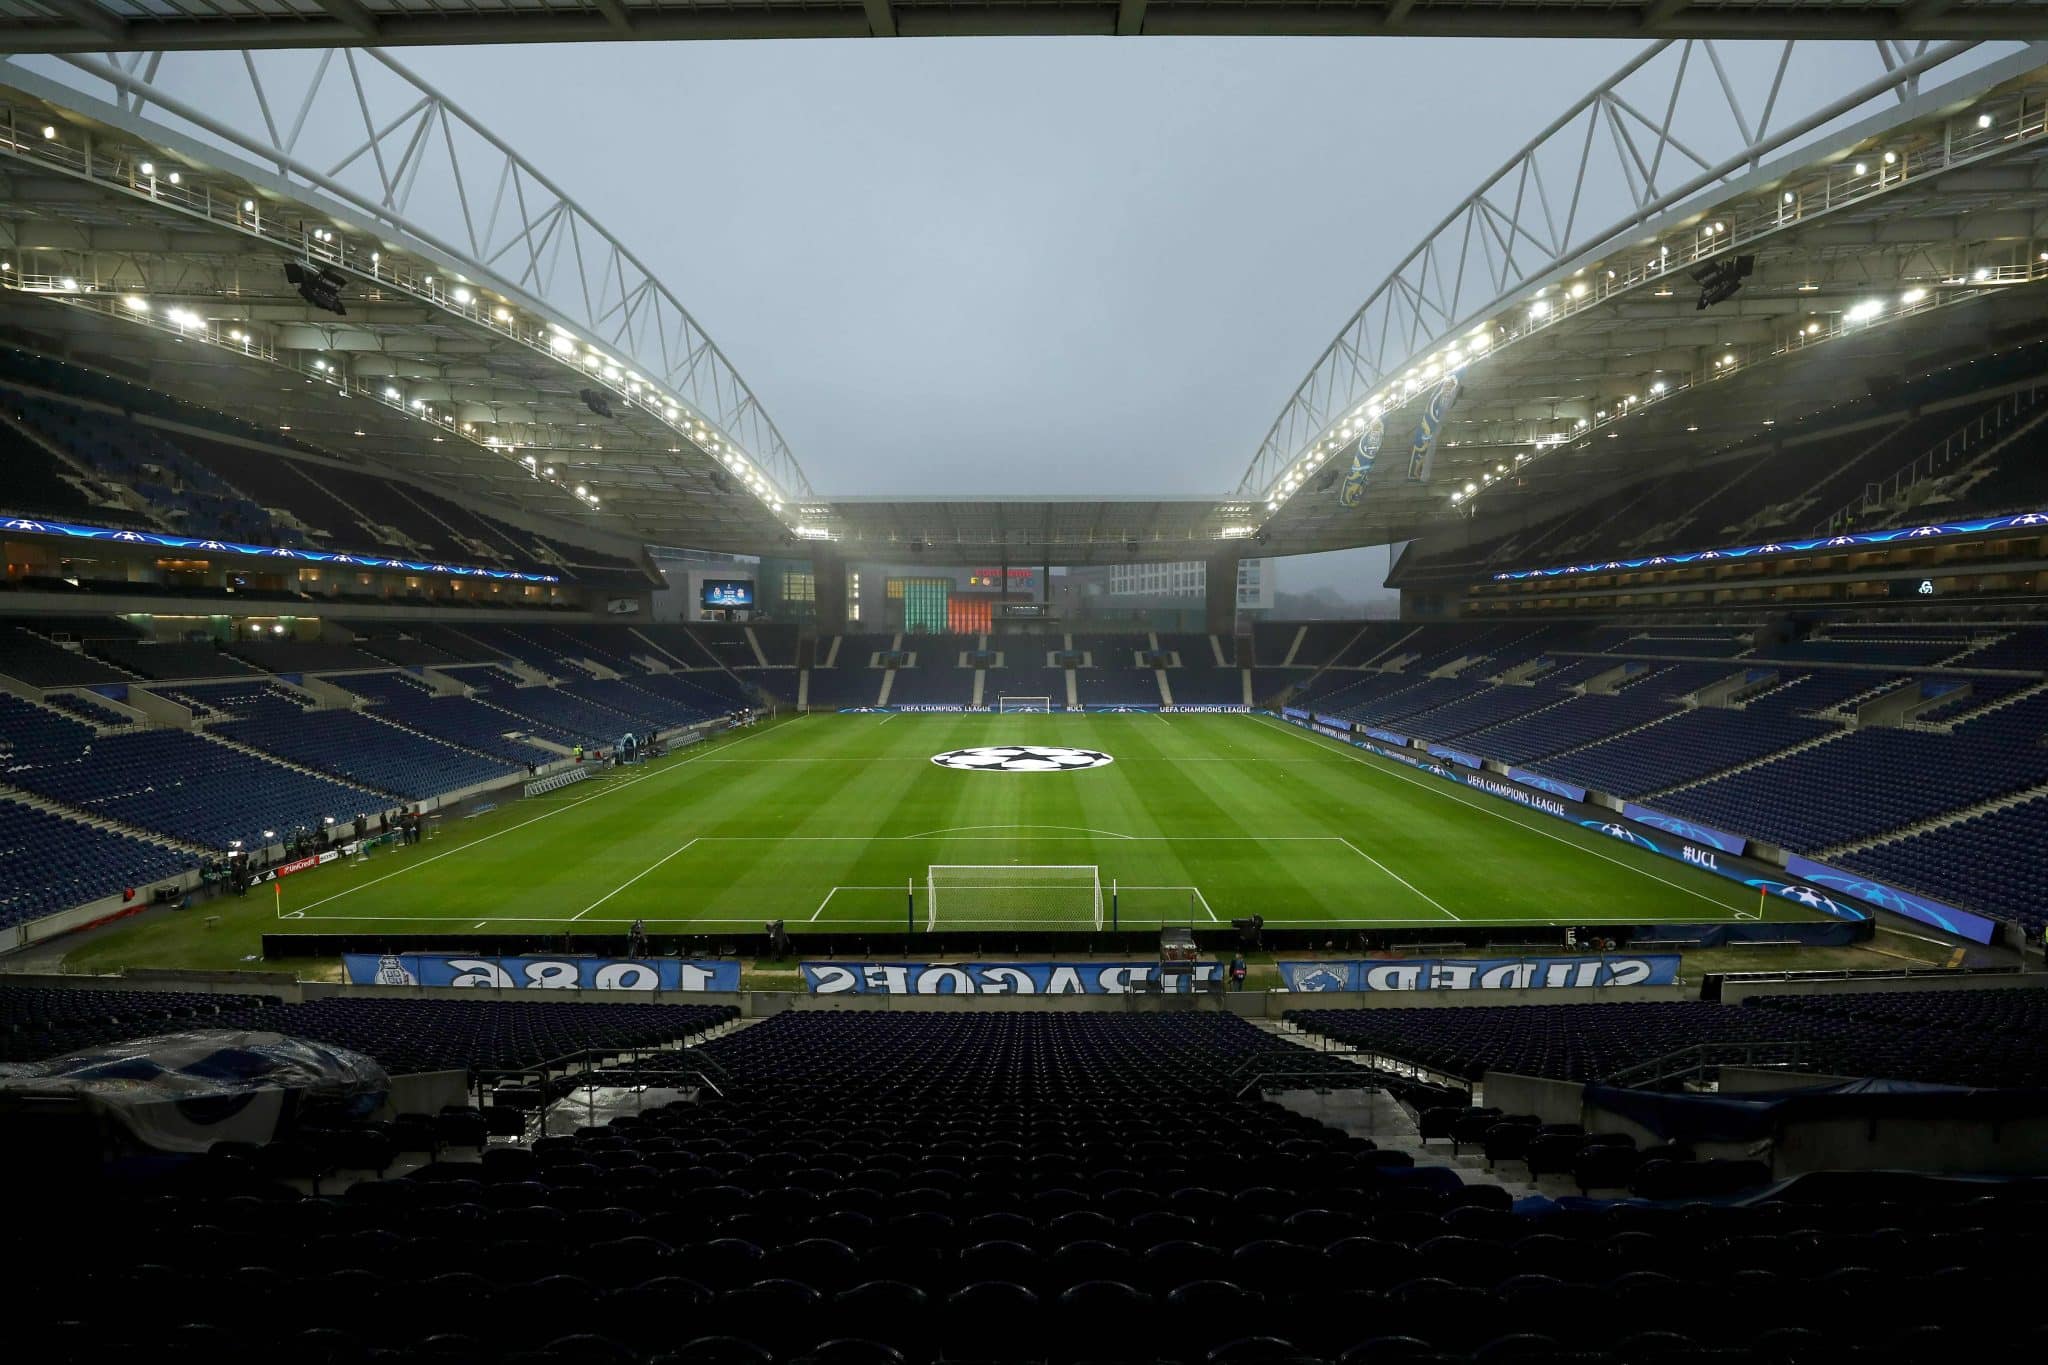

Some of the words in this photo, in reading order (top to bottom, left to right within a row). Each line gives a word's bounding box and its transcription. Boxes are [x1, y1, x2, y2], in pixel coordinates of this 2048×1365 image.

[1467, 774, 1485, 788] UEFA
[1485, 780, 1529, 804] CHAMPIONS
[1531, 795, 1565, 816] LEAGUE
[289, 858, 315, 872] UniCredit
[1682, 845, 1718, 870] #UCL
